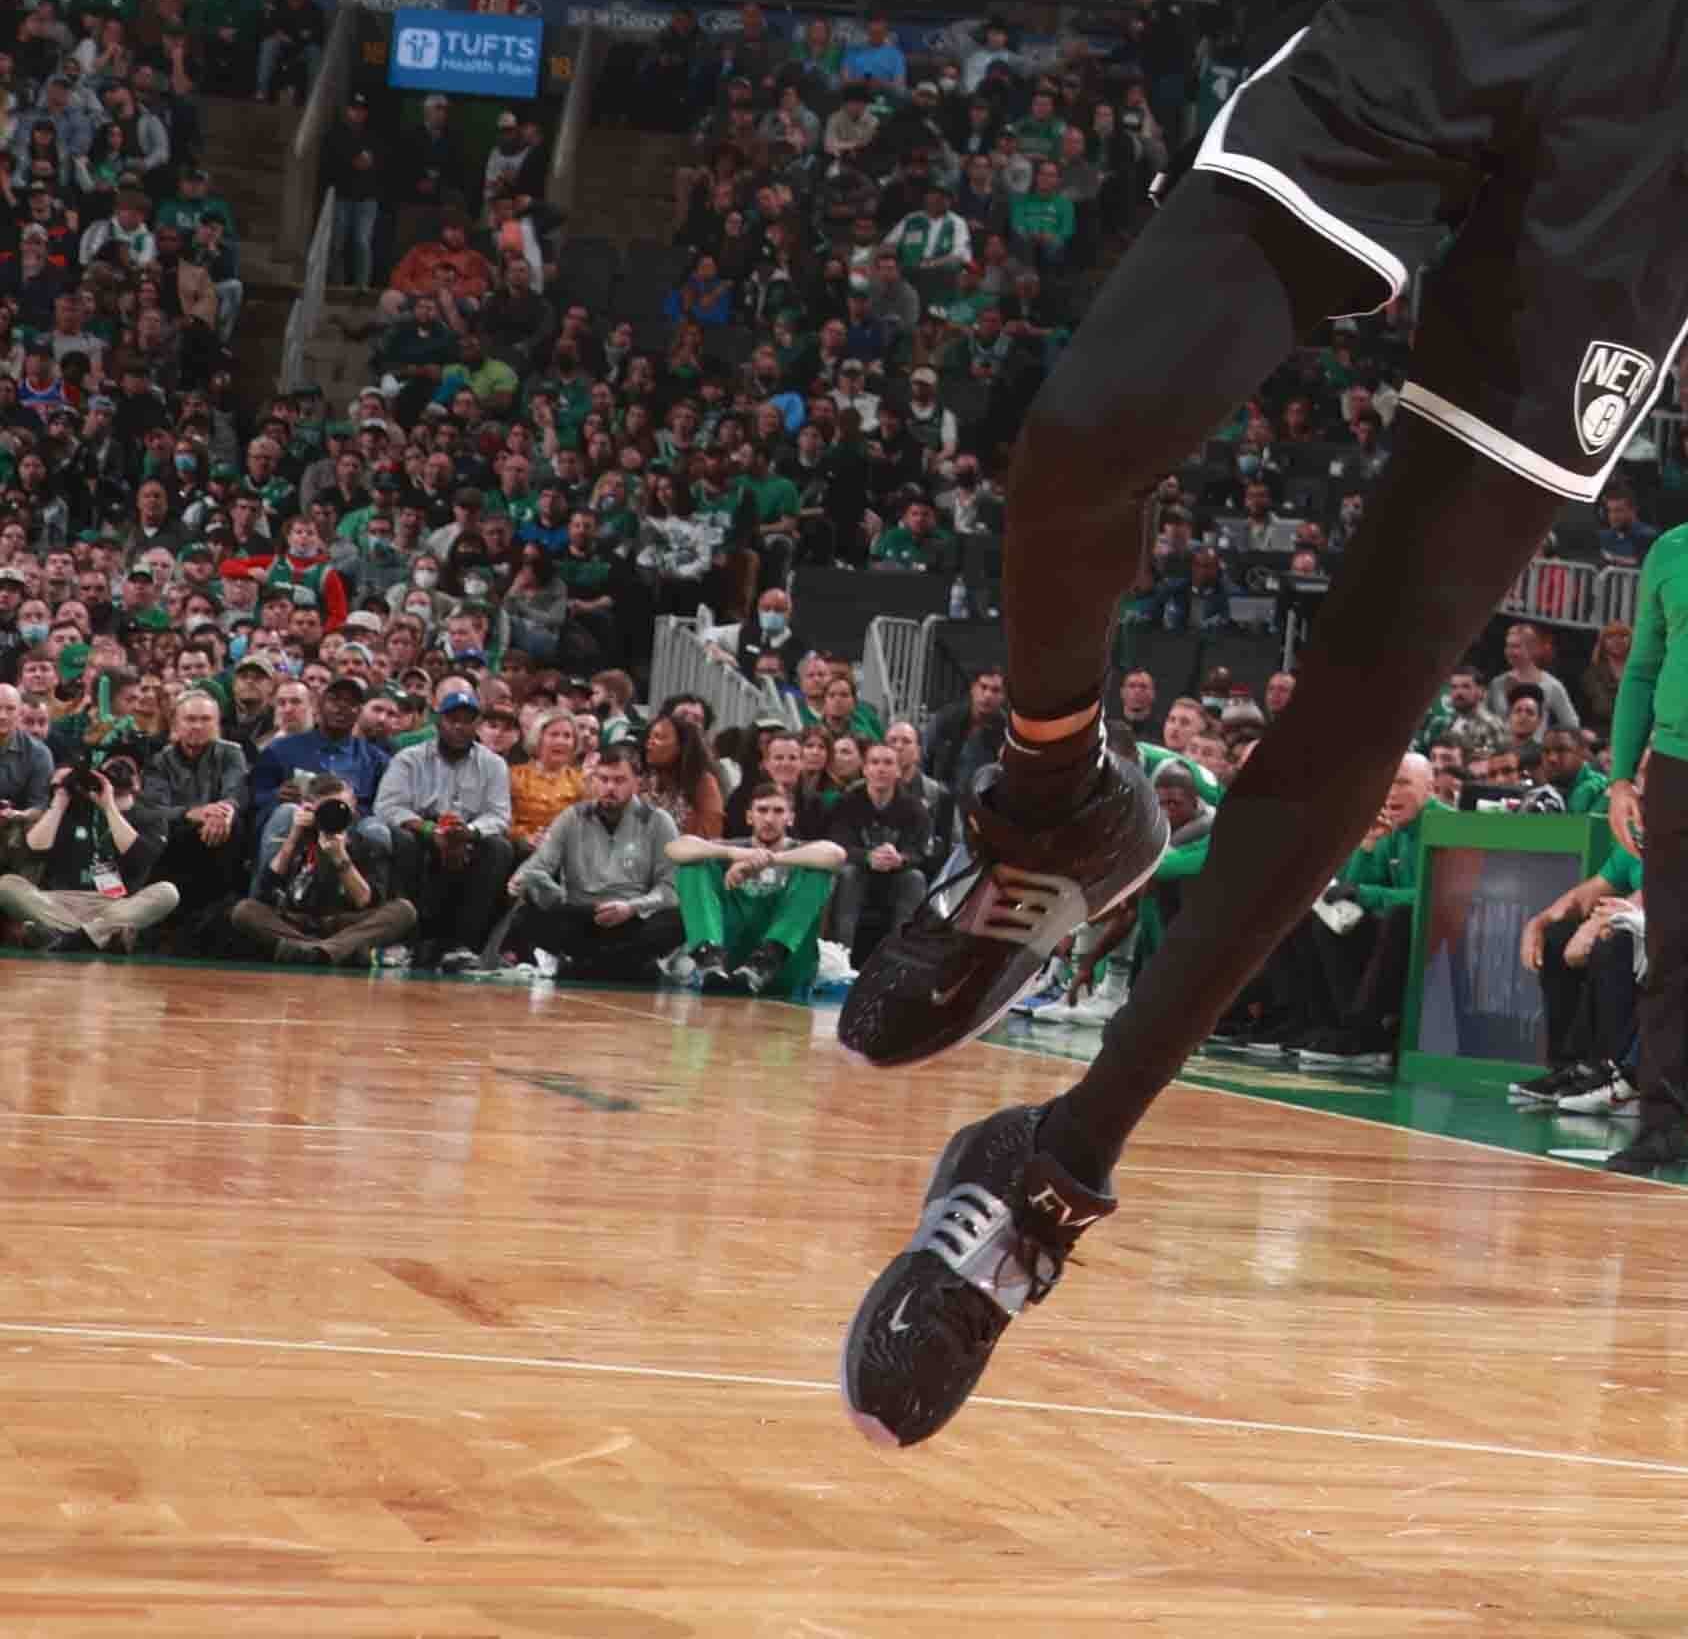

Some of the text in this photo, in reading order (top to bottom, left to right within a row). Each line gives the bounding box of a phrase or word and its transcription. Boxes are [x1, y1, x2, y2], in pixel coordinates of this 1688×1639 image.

[443, 30, 535, 60] TUFTS
[441, 57, 534, 77] Health Plan
